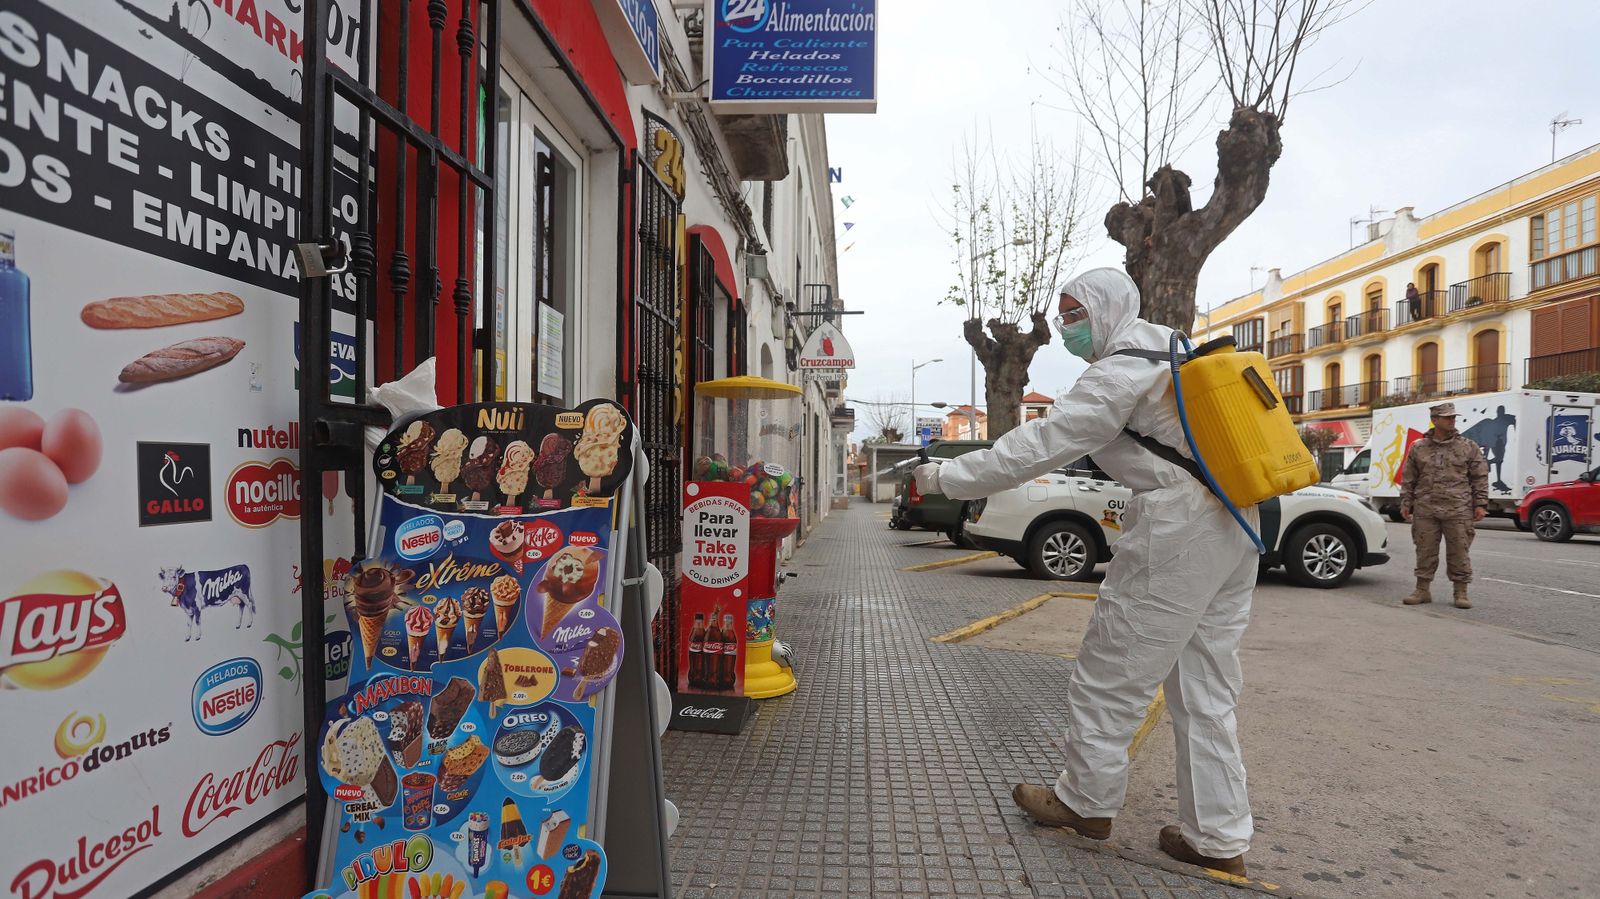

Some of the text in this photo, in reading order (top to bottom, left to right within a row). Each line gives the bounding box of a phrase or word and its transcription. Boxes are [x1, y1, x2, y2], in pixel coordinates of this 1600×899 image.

[725, 0, 873, 32] 24 Alimentación
[722, 37, 869, 49] Pan Caliente
[748, 50, 841, 60] Helados
[740, 62, 849, 72] Refrescos
[735, 74, 853, 84] Bocadillos
[0, 11, 231, 162] SNACKS
[725, 86, 862, 97] Charcutería
[800, 358, 853, 368] Cruzcampo
[558, 415, 581, 424] NUEVO
[238, 422, 299, 449] nutell
[147, 497, 205, 514] GALLO
[689, 499, 723, 514] BEBIDAS
[402, 518, 435, 532] HELADOS
[699, 511, 734, 525] Para
[694, 525, 738, 538] llevar
[570, 535, 596, 543] nuevo
[695, 540, 736, 554] Take
[693, 554, 738, 569] away
[689, 569, 740, 585] COLD DRINKS
[202, 572, 243, 600] Milka
[552, 624, 593, 644] Milka
[206, 664, 249, 687] HELADOS
[504, 663, 554, 674] TOBLERONE
[202, 682, 255, 720] Nestlé
[354, 676, 432, 715] MAXIBON
[502, 713, 548, 727] OREO
[181, 729, 303, 838] Coca-Cola
[335, 789, 362, 797] nuevo
[345, 802, 378, 812] CEREAL
[354, 812, 370, 822] MIX
[10, 804, 163, 899] Dulcesol
